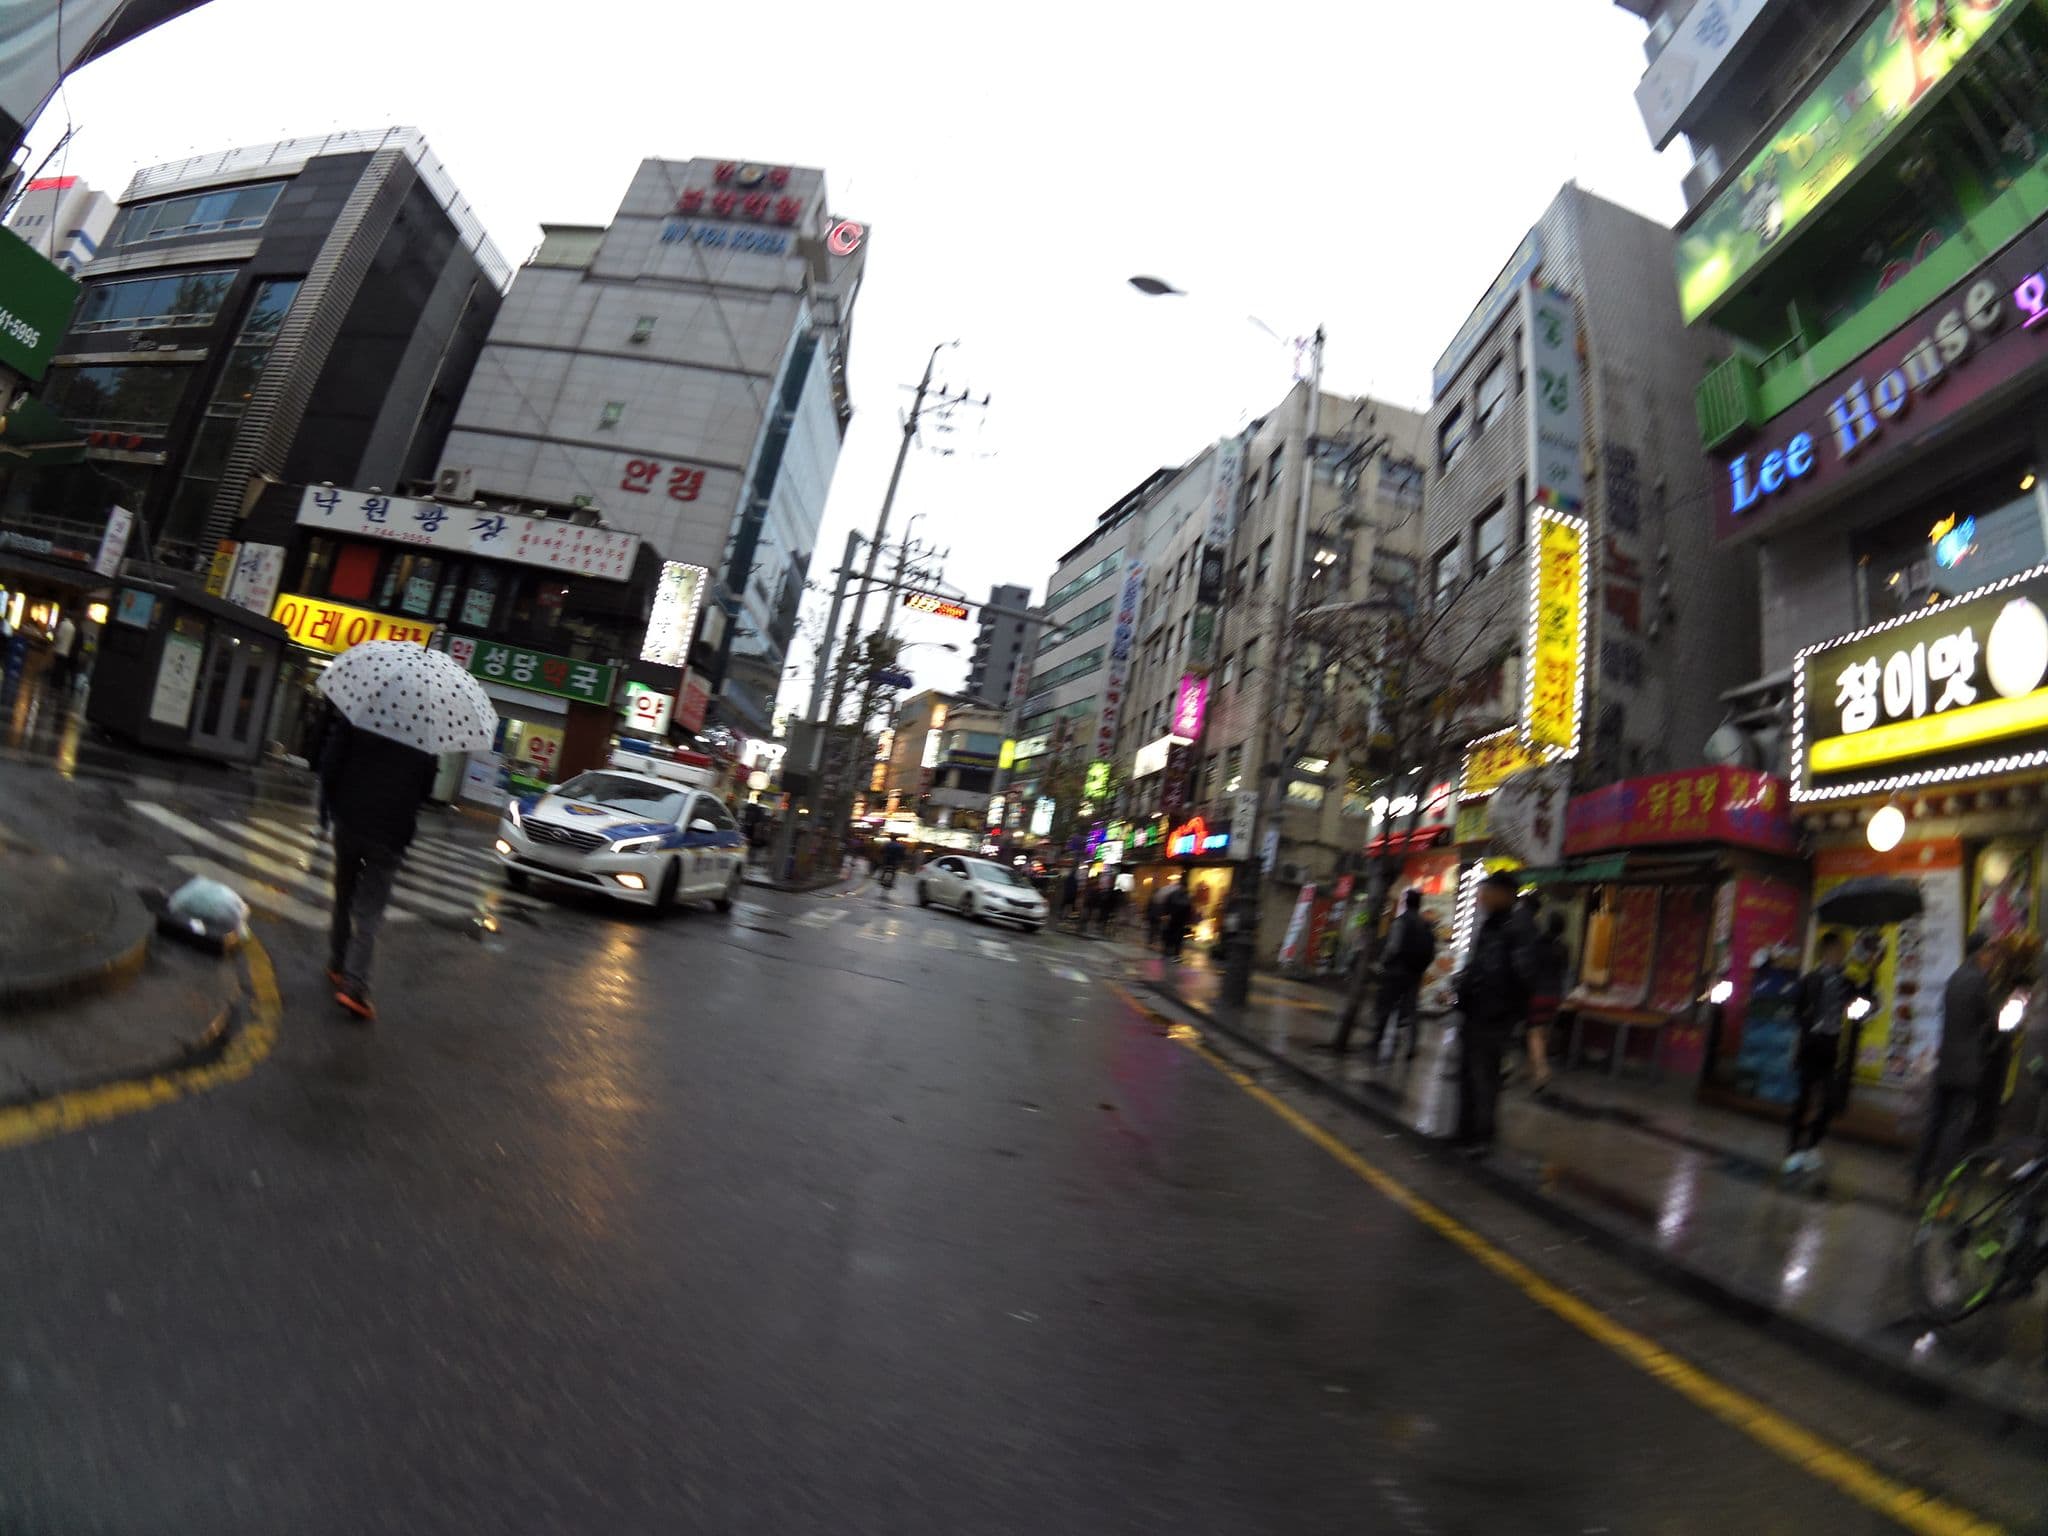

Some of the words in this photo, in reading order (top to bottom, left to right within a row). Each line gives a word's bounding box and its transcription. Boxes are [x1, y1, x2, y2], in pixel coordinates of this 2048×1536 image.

[1729, 431, 1814, 513] Lee
[1825, 280, 2002, 459] House
[620, 459, 706, 502] 안경
[484, 647, 600, 697] 성당약국
[637, 696, 665, 729] 약
